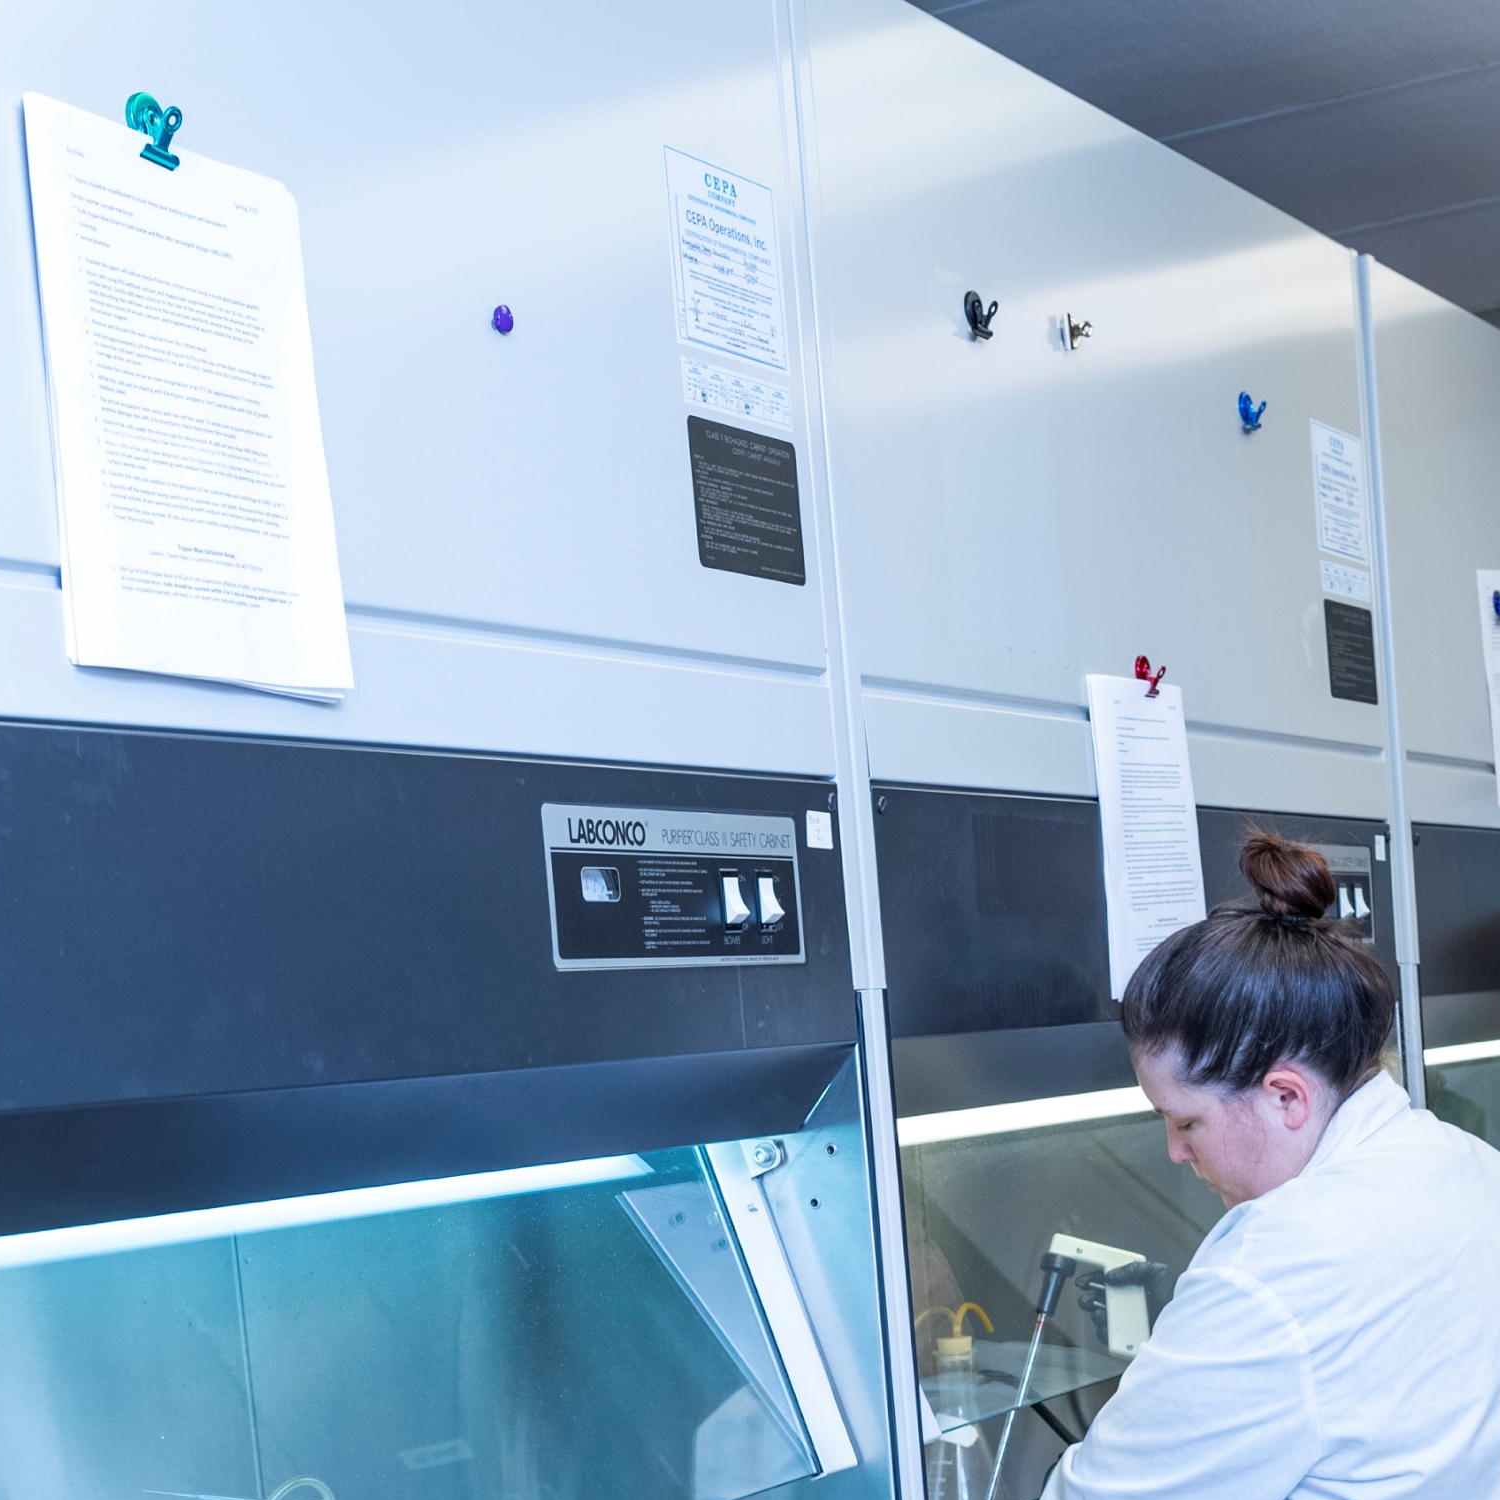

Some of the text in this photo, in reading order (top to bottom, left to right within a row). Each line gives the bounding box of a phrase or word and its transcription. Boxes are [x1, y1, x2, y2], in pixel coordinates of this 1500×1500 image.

[704, 173, 738, 198] CEPA
[707, 190, 736, 207] COMPANY
[685, 209, 768, 252] CEPA Operations, Inc.
[749, 441, 767, 452] CABINET
[767, 446, 791, 460] OPERATION
[567, 817, 646, 847] LABCONCO
[693, 830, 721, 847] CLASS
[730, 831, 757, 848] SAFETY
[758, 833, 791, 850] CABINET
